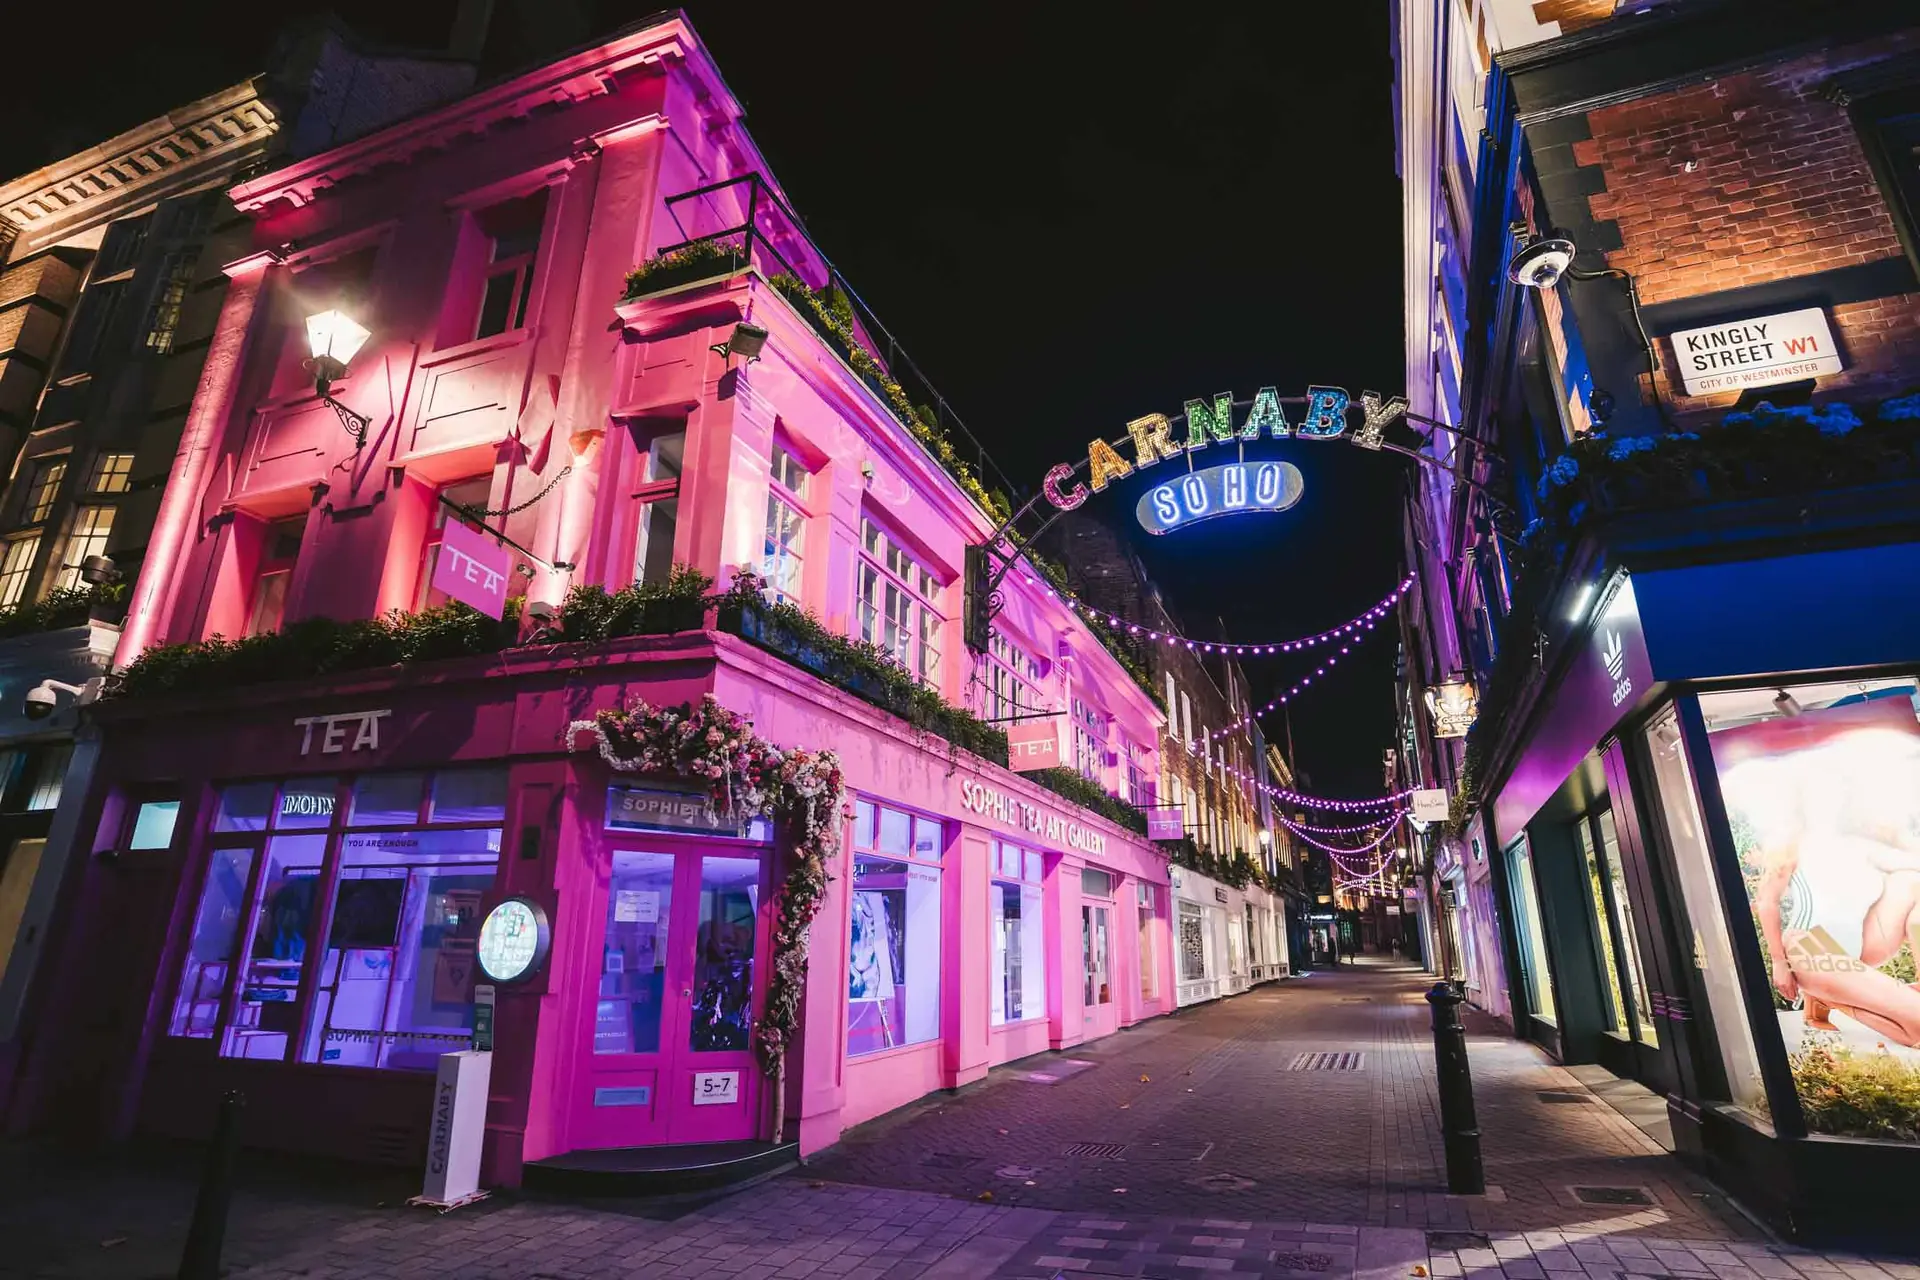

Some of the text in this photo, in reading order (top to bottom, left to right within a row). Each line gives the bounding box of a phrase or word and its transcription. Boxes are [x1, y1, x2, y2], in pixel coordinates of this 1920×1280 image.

[1687, 324, 1768, 352] KINGLY
[1693, 335, 1819, 371] STREET W1
[1700, 362, 1819, 390] CITY OF WESTMINSTER
[1043, 385, 1410, 511] CARNABY
[1152, 461, 1283, 525] SOHO
[446, 544, 505, 595] TEA
[1612, 676, 1632, 708] adidas
[294, 709, 392, 756] TEA
[1011, 738, 1056, 757] TEA
[961, 779, 1107, 856] SOPHIE TEA ART GALLERY
[347, 839, 364, 848] YOU
[366, 839, 383, 848] ARE
[703, 1077, 731, 1093] 5-7
[430, 1081, 453, 1175] CARNABY
